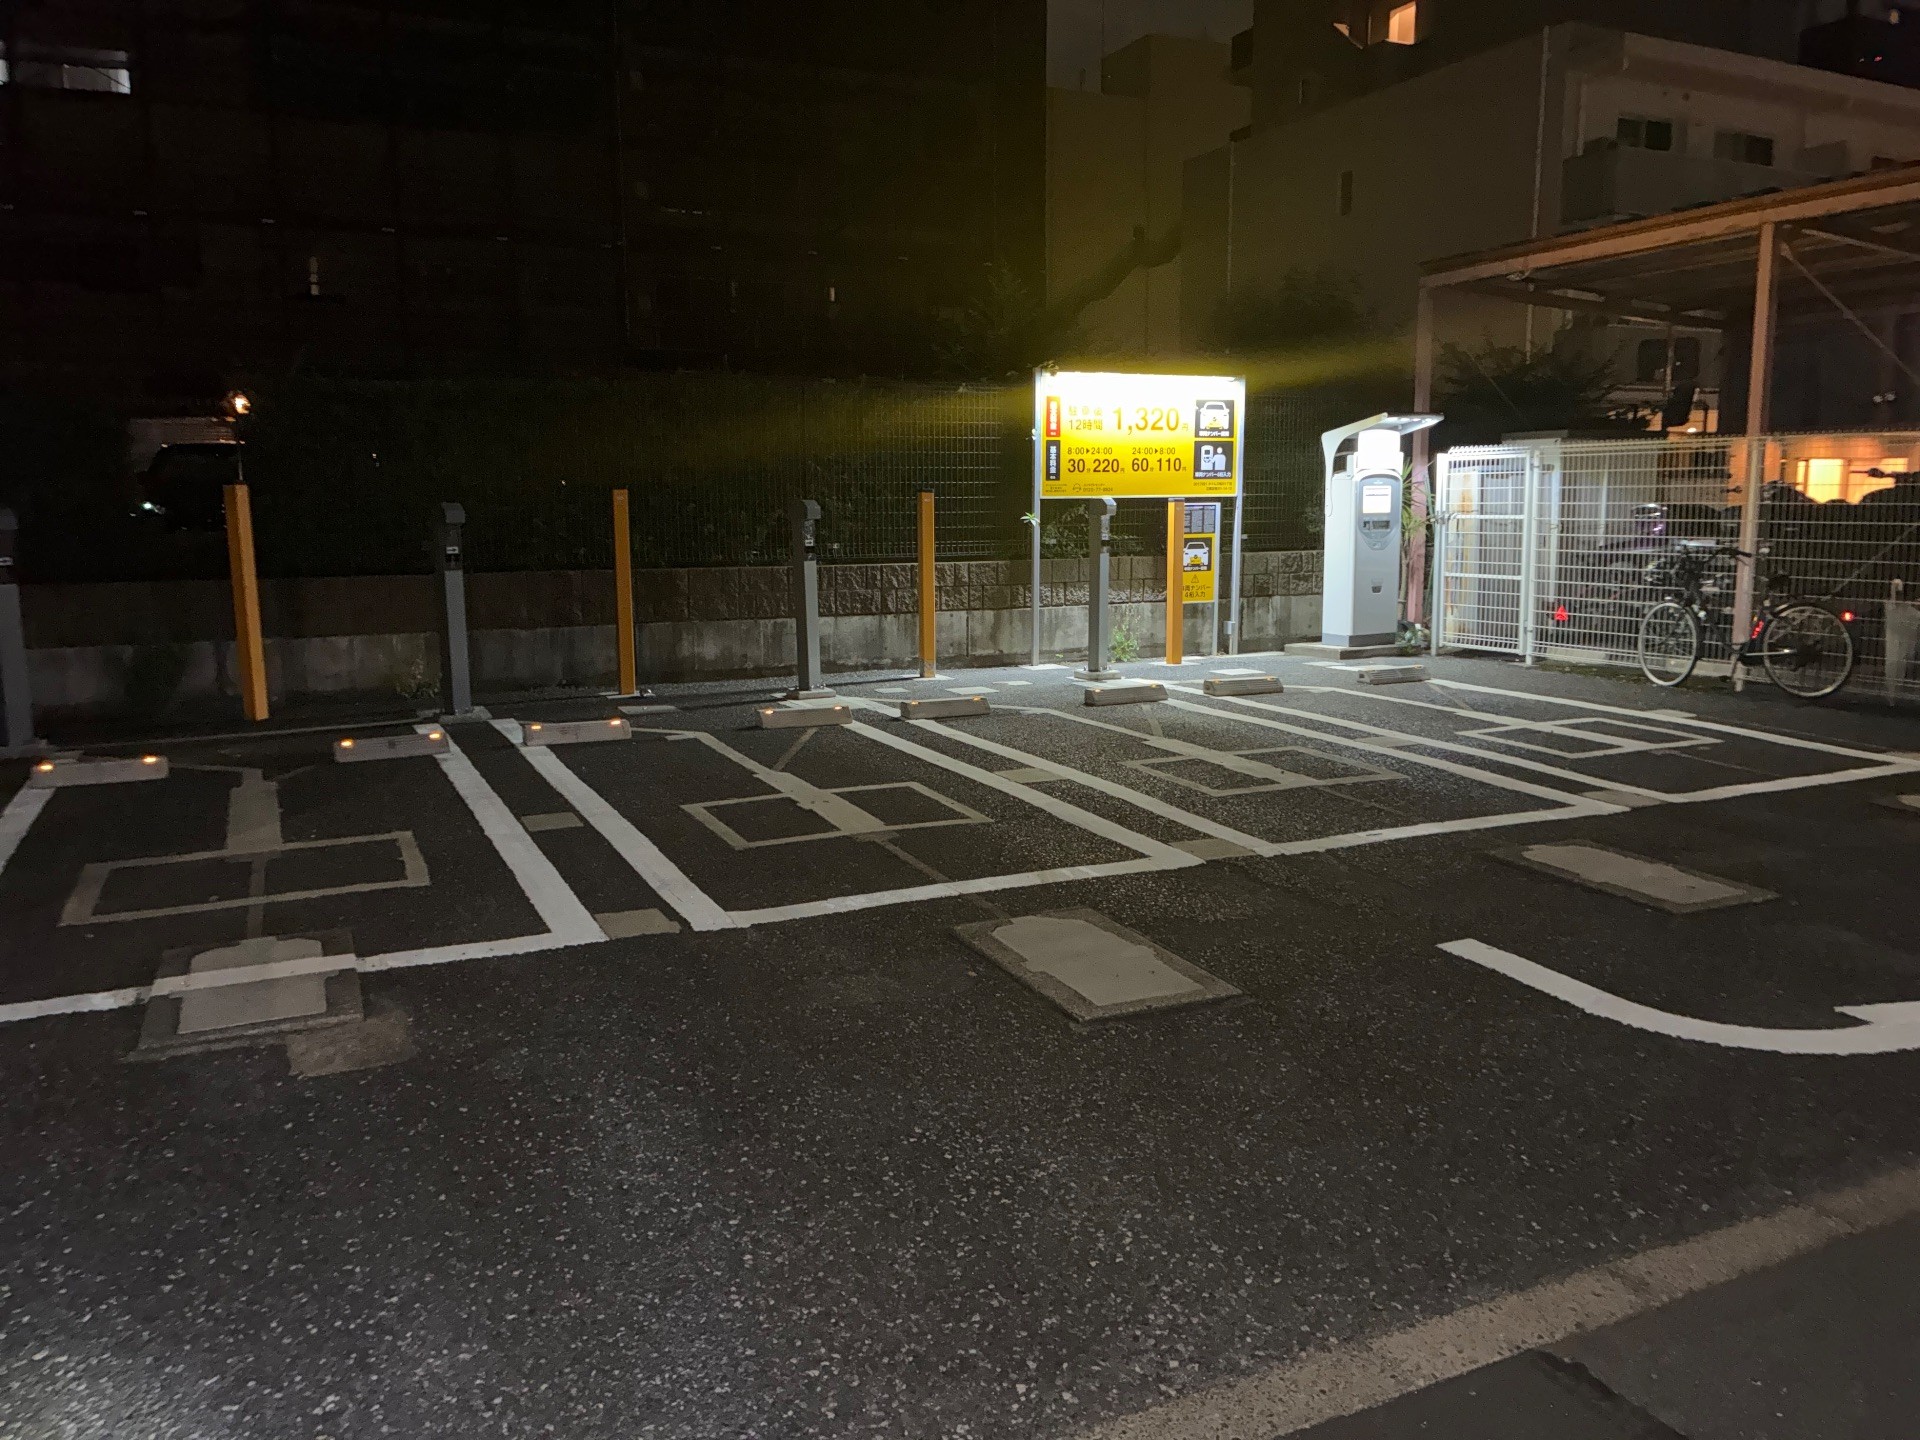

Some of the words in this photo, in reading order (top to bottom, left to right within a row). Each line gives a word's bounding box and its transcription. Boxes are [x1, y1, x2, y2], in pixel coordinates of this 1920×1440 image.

[1068, 419, 1103, 431] 12時間
[1067, 447, 1085, 455] 8:00
[1091, 447, 1113, 455] 24:00
[1132, 447, 1153, 455] 24:00
[1159, 447, 1176, 455] 8:00
